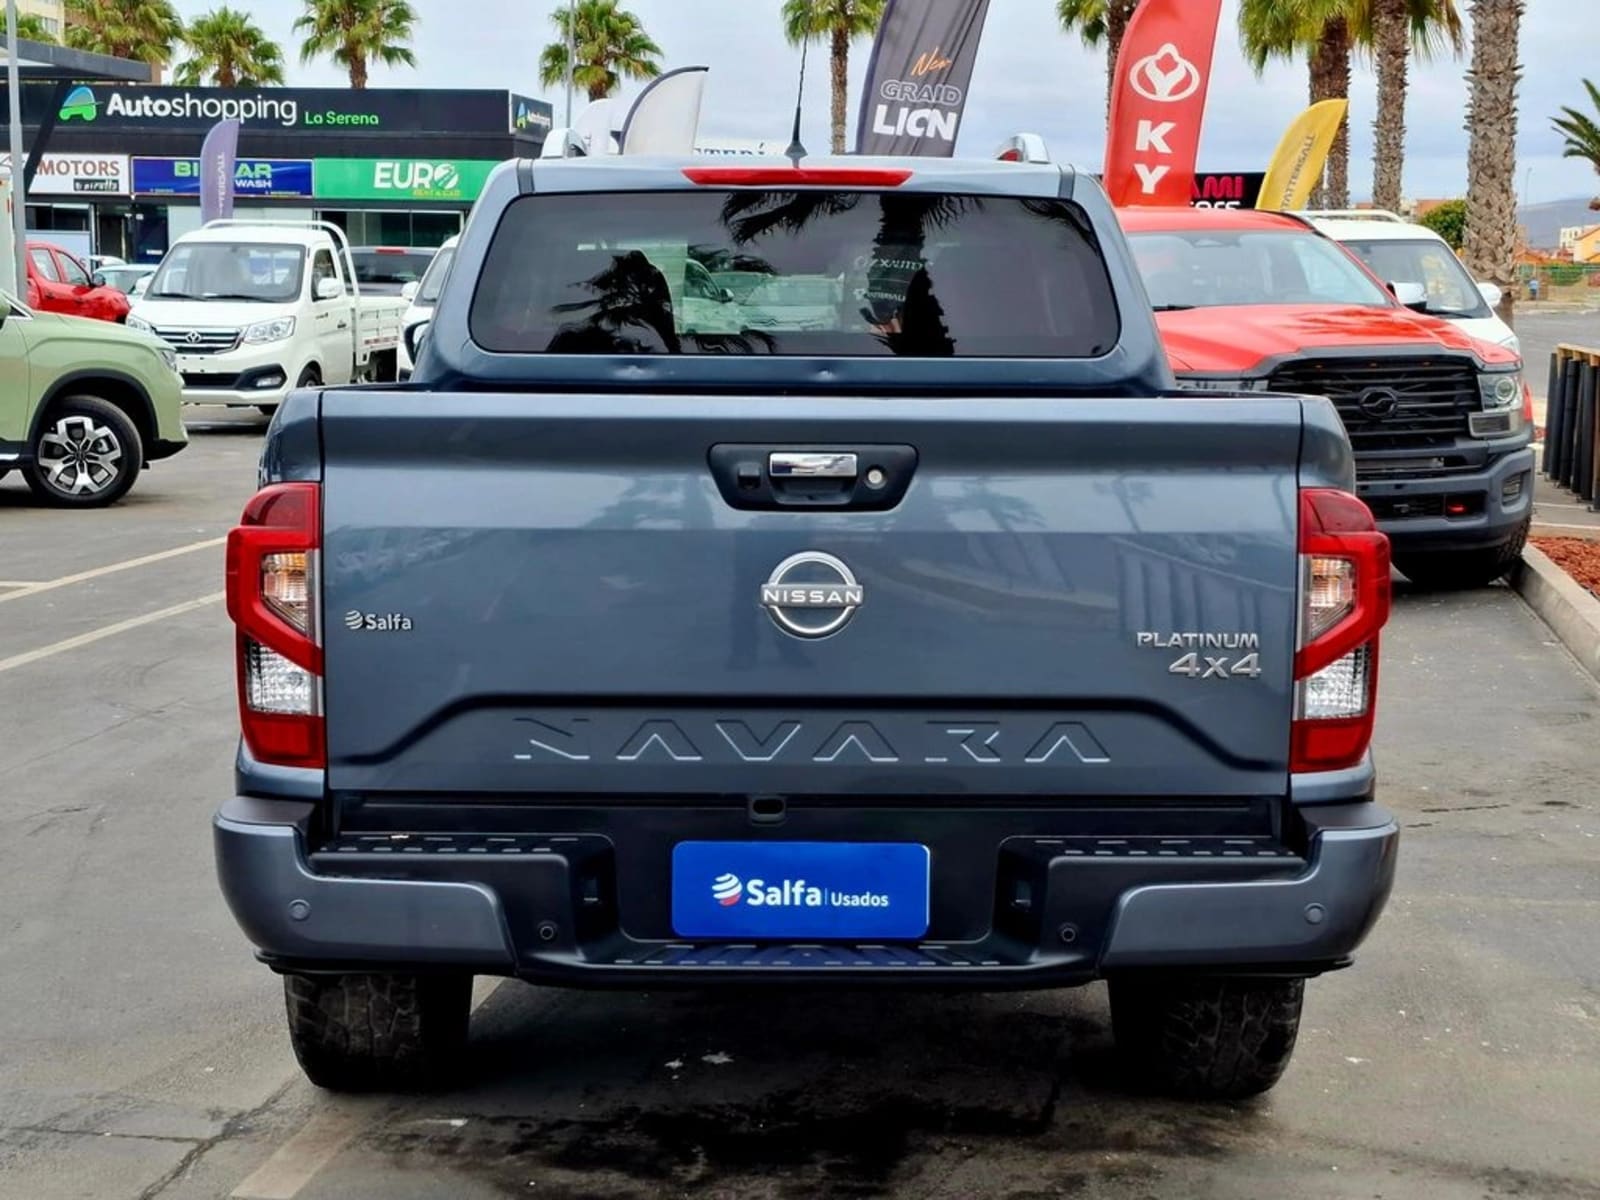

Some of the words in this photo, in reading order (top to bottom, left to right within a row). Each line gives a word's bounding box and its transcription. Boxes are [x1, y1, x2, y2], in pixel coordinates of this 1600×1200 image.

[107, 92, 297, 126] Autoshopping
[305, 112, 323, 125] La
[326, 112, 379, 125] Serena
[234, 180, 272, 188] WASH
[373, 162, 459, 190] EURO
[763, 589, 861, 603] NISSAN
[365, 613, 412, 630] Salfa
[1137, 632, 1260, 648] PLATINUM
[513, 718, 1111, 762] NAVARA
[747, 879, 822, 906] Salfa
[830, 891, 889, 907] Usados
